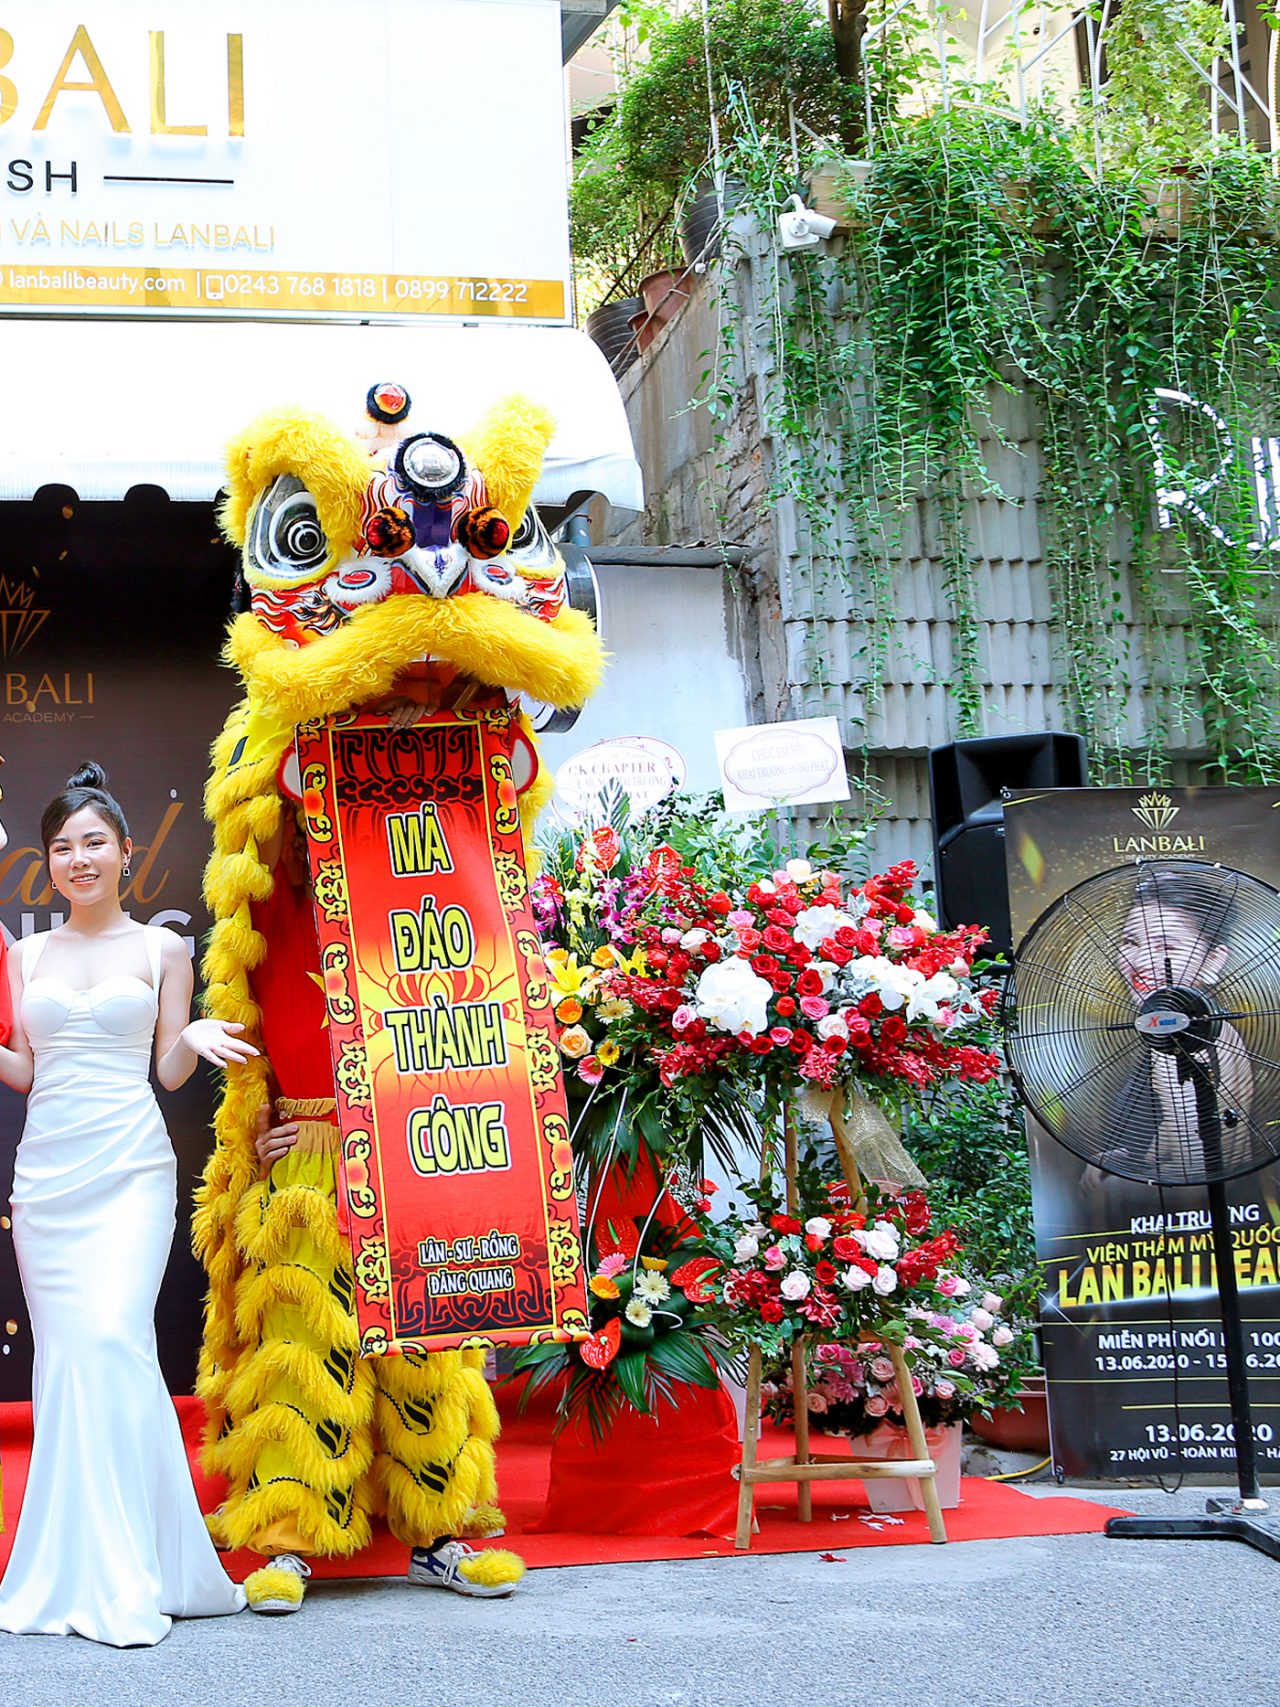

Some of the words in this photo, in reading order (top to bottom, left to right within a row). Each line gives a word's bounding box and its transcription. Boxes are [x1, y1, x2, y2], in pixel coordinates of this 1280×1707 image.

[11, 211, 51, 241] VÀ
[61, 219, 145, 243] NAILS
[154, 222, 275, 248] LANBALI
[225, 274, 280, 296] 0243
[288, 275, 326, 297] 768
[332, 277, 376, 298] 1818
[394, 279, 450, 301] 0899
[456, 280, 529, 303] 712222
[3, 711, 76, 723] ACADEMY
[591, 762, 656, 775] CHAPTER
[387, 802, 454, 877] MÃ
[1113, 836, 1205, 853] LANBALI
[390, 896, 472, 973] ĐÁO
[384, 994, 508, 1074] THÀNH
[408, 1093, 511, 1177] CÔNG
[1130, 1212, 1173, 1235] KHAI
[1175, 1203, 1260, 1231] TRƯNG
[419, 1240, 447, 1266] LÂN
[455, 1240, 475, 1263] SƯ
[480, 1232, 518, 1260] RỒNG
[1086, 1242, 1129, 1266] VIỆN
[429, 1270, 467, 1297] ĐĂNG
[467, 1267, 514, 1296] QUANG
[1058, 1263, 1125, 1308] LAN
[1132, 1252, 1200, 1301] BALI
[1210, 1246, 1280, 1292] EA
[1098, 1328, 1144, 1350] MIỄN
[1147, 1329, 1177, 1348] PHÍ
[1180, 1327, 1216, 1347] NỐI
[1095, 1353, 1190, 1372] 13.06.2020
[1145, 1423, 1273, 1444] 13.06.20
[1110, 1450, 1126, 1461] 27
[1128, 1447, 1150, 1462] HỘI
[1153, 1446, 1169, 1460] VŨ
